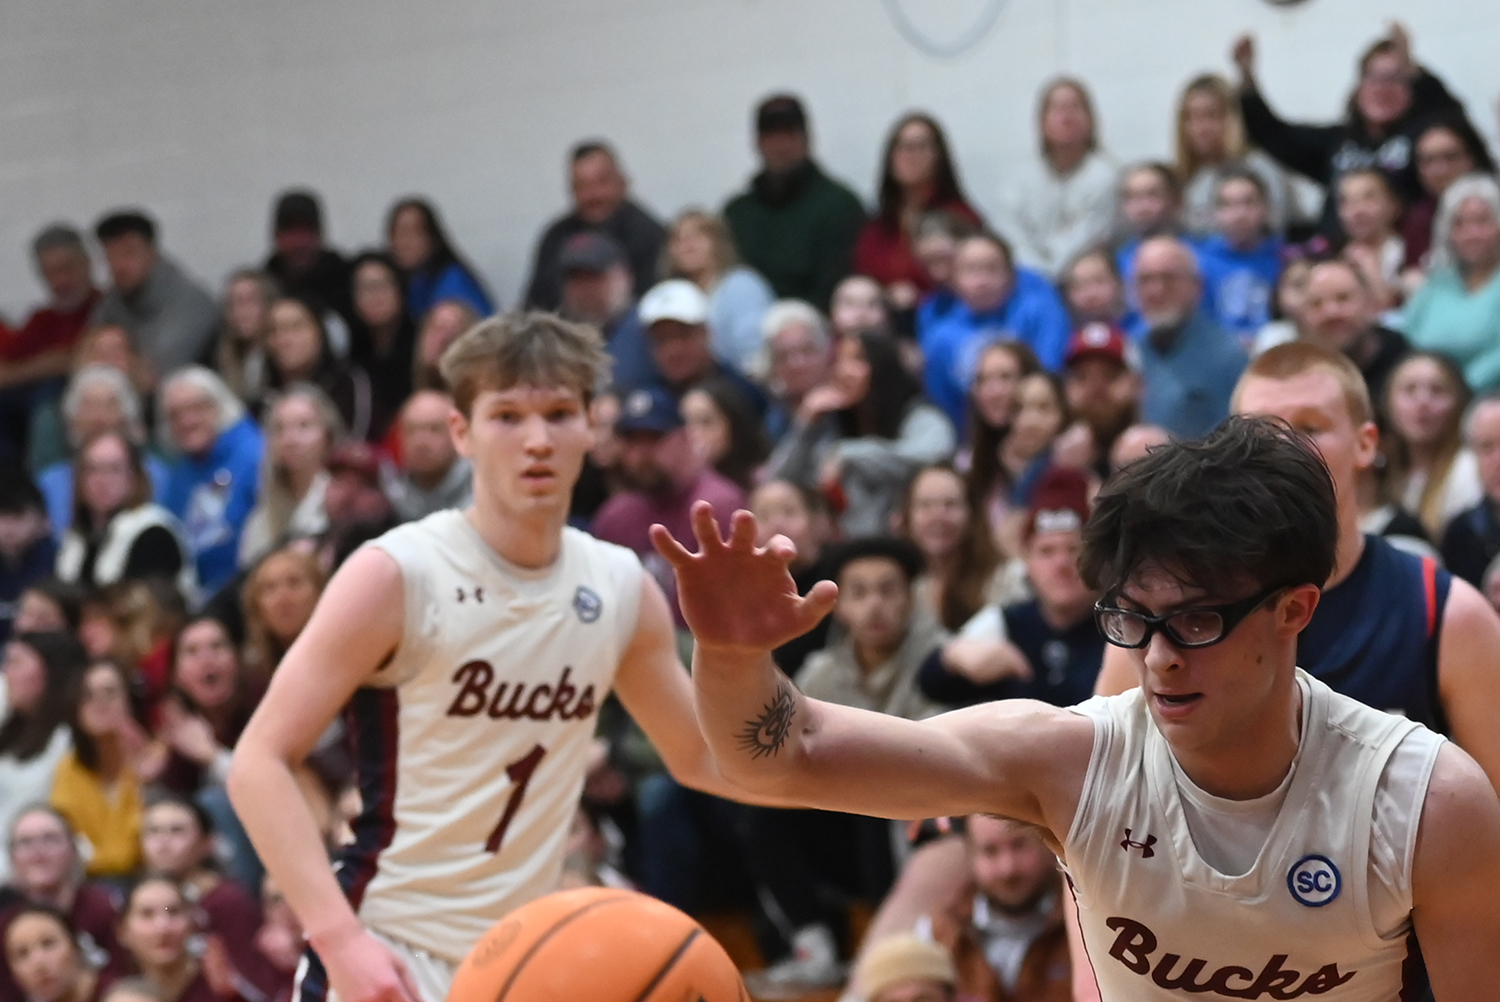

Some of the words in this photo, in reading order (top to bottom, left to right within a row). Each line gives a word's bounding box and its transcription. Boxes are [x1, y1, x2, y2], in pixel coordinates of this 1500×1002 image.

[446, 659, 597, 722] Bucks
[484, 743, 547, 855] 1
[1296, 869, 1332, 893] SC
[1105, 916, 1358, 1001] Bucks
